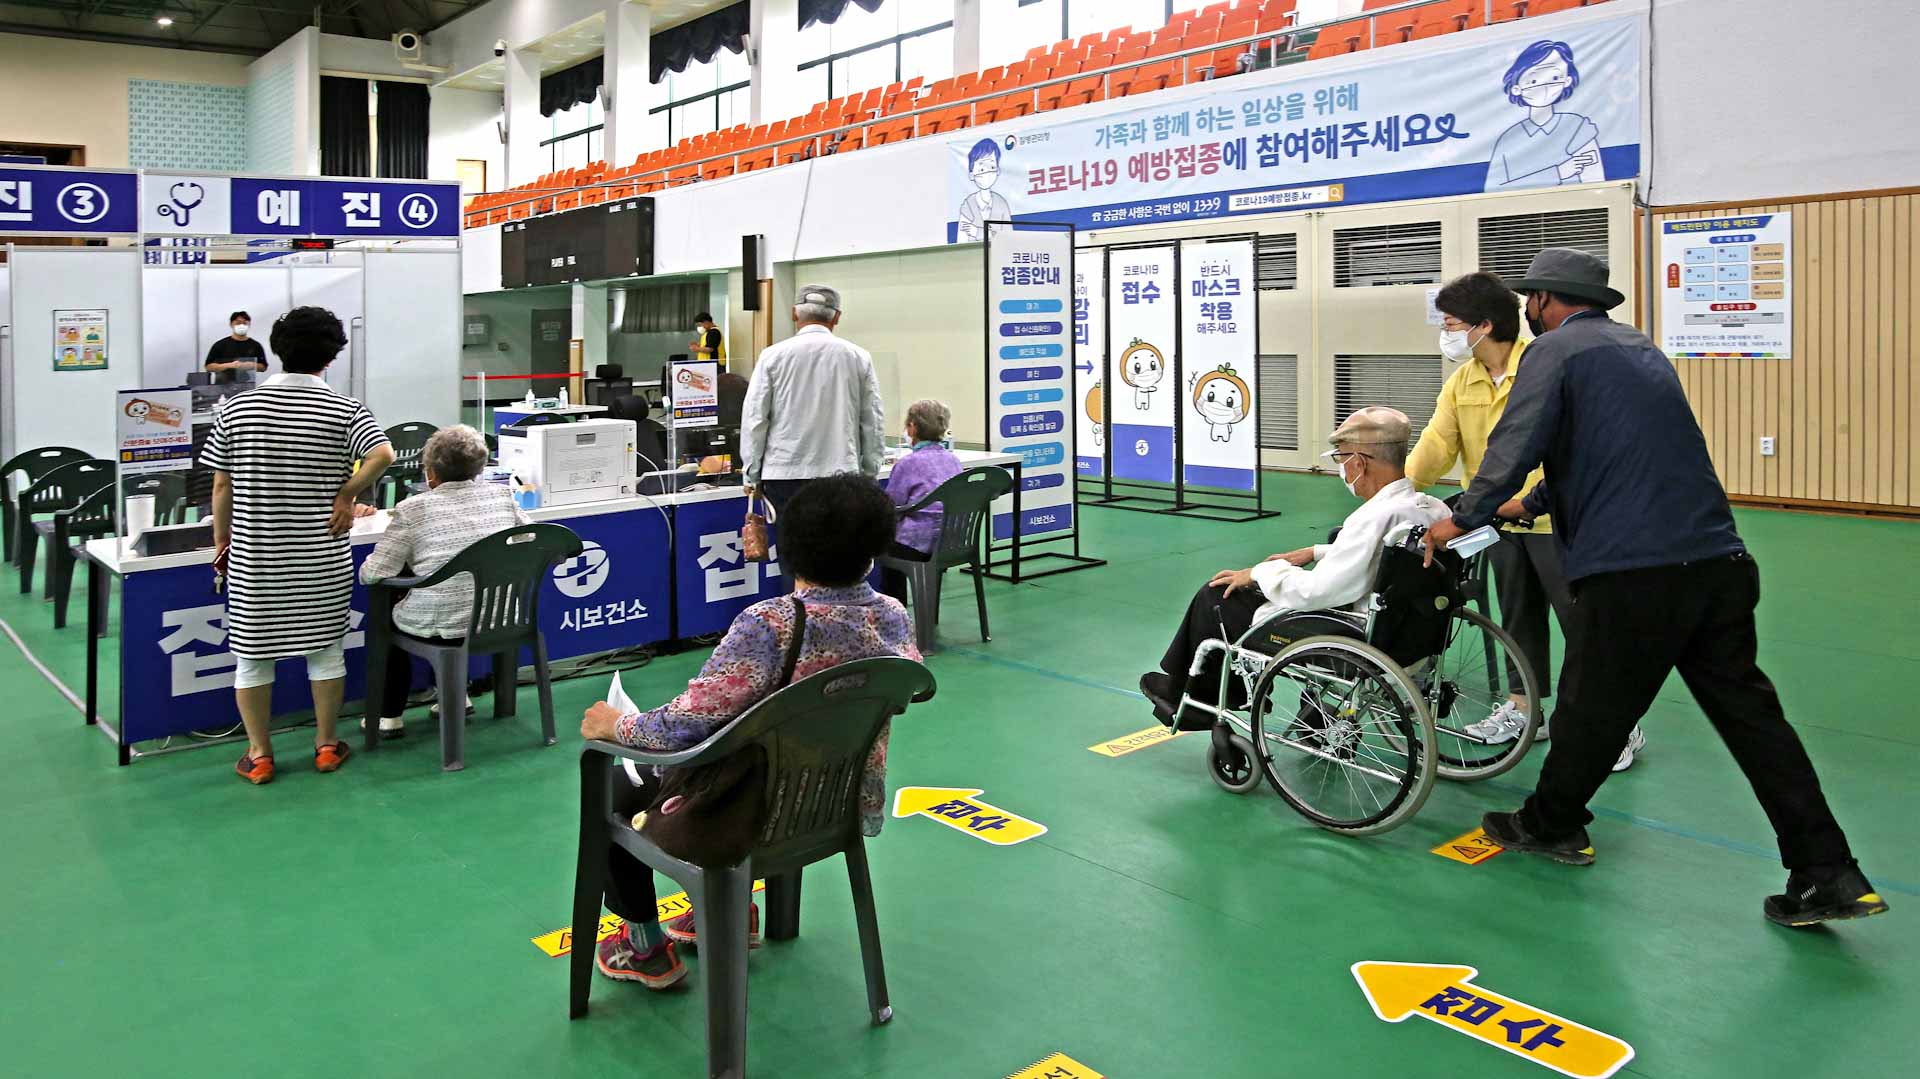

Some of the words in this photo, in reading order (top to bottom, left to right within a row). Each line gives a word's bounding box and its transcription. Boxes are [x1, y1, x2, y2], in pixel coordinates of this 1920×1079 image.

[1095, 118, 1148, 150] 가족과
[1152, 111, 1190, 142] 함께
[1196, 106, 1235, 133] 하는
[1242, 91, 1306, 126] 일상을
[1313, 82, 1359, 116] 위해
[1027, 158, 1118, 195] 코로나19
[1128, 137, 1247, 184] 예방접종에
[1256, 113, 1436, 169] 참여해주세요
[1235, 191, 1312, 206] 코로나19예방접종.kr
[1103, 208, 1127, 222] 궁금한
[1128, 205, 1153, 219] 사항은
[1154, 203, 1171, 216] 국번
[1173, 201, 1190, 214] 없이
[1193, 197, 1221, 213] 1339
[1012, 252, 1050, 264] 코로나19
[1001, 266, 1060, 285] 접종안내
[1123, 264, 1159, 276] 코로나19
[1200, 264, 1231, 277] 반드시
[1121, 280, 1161, 305] 접수
[1192, 278, 1241, 298] 마스크
[1200, 301, 1233, 321] 착용
[1197, 322, 1237, 334] 해주세요
[1030, 514, 1057, 525] 시보건소
[560, 598, 648, 632] 시보건소
[926, 799, 1011, 832] 접수
[1419, 985, 1566, 1051] 접수
